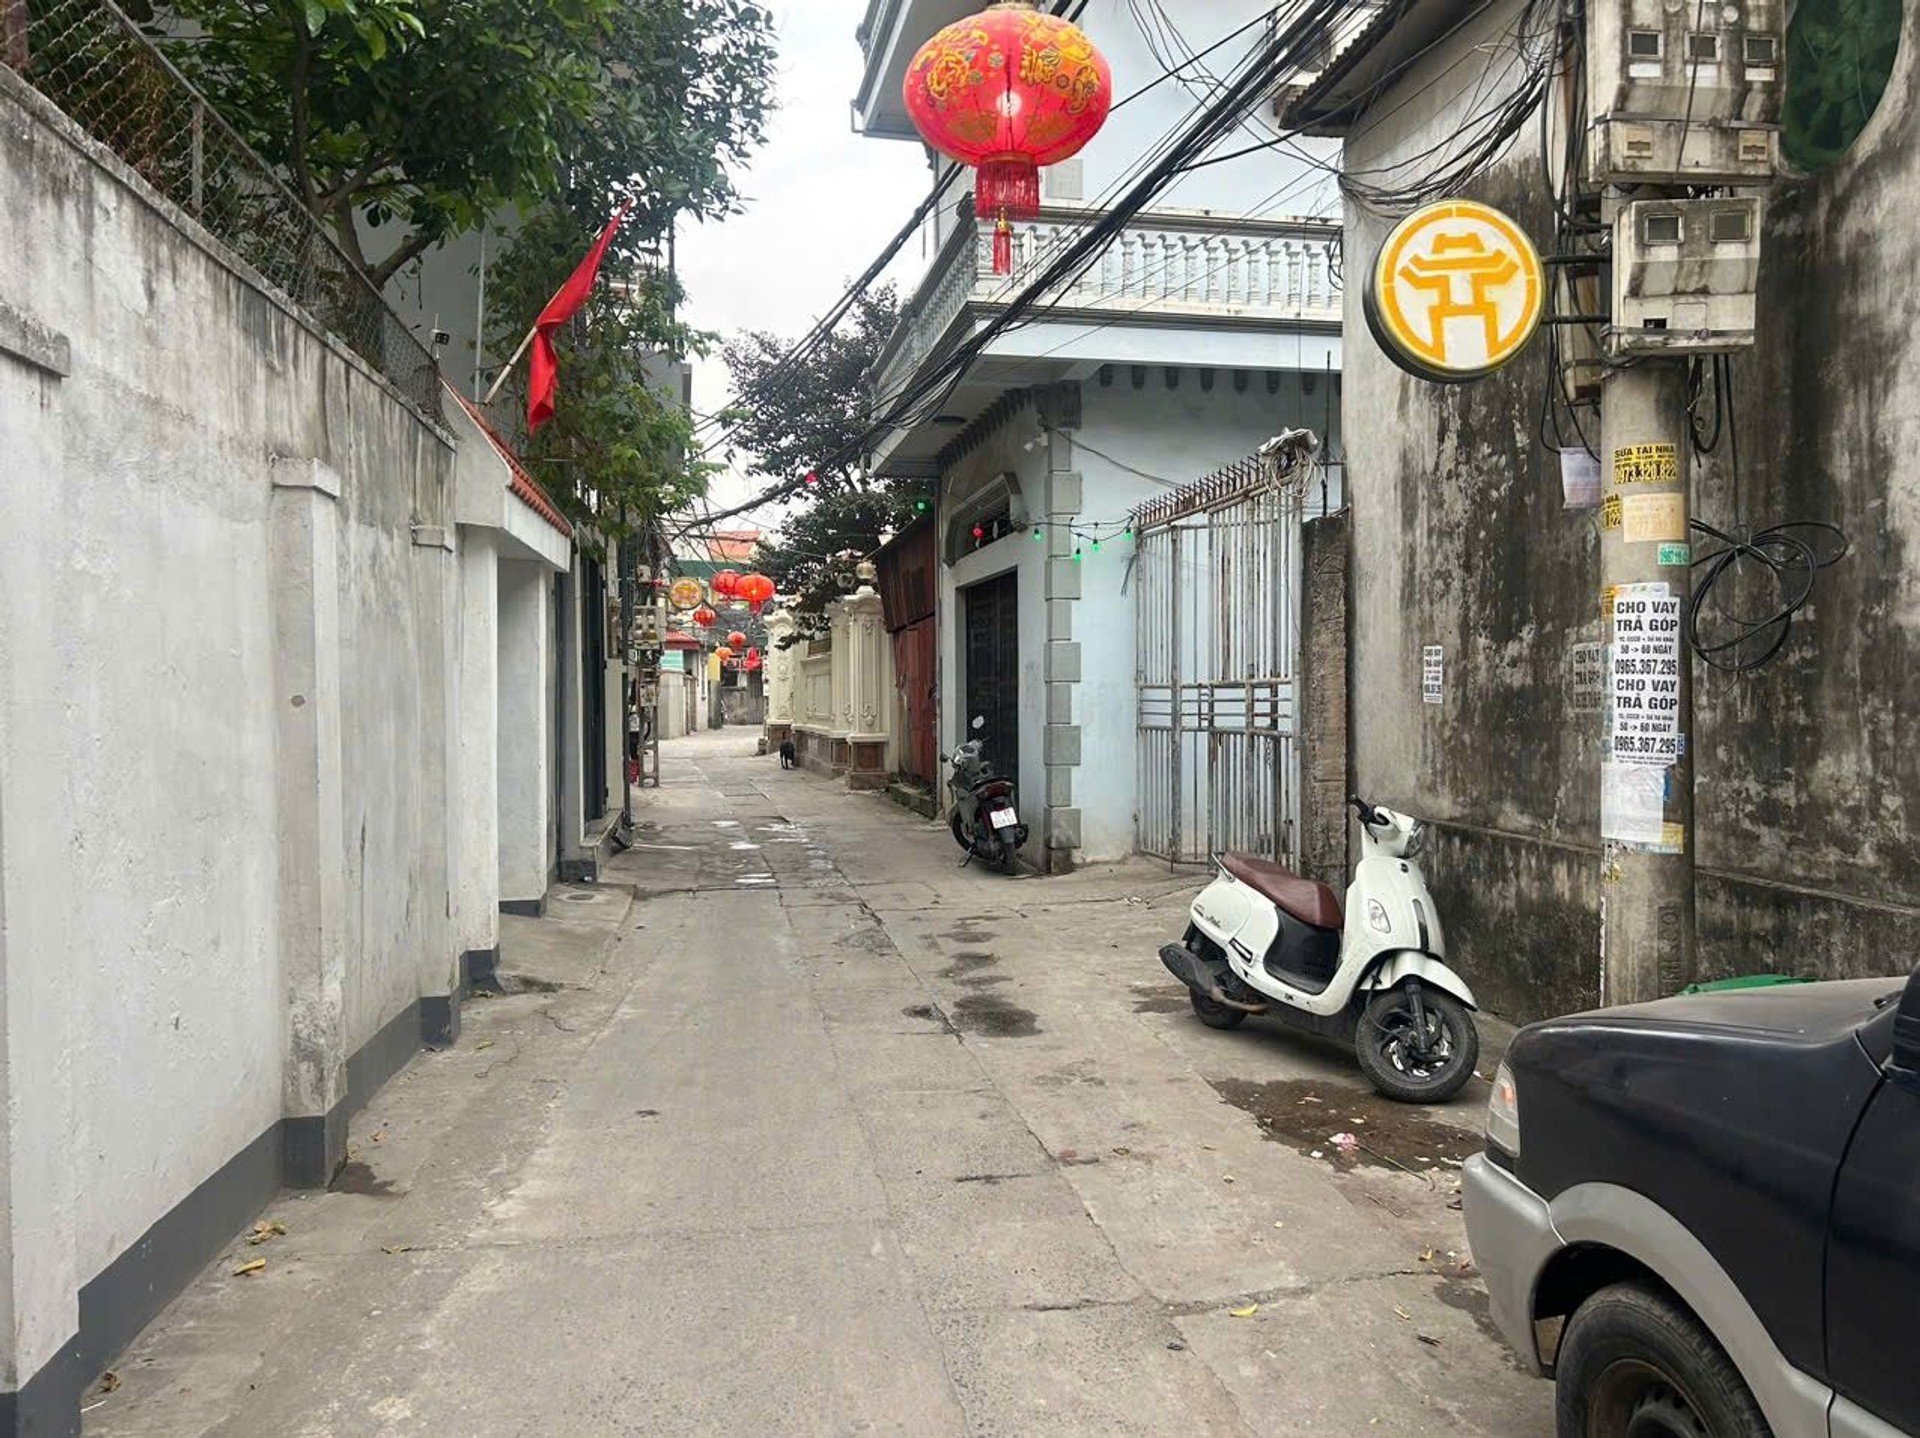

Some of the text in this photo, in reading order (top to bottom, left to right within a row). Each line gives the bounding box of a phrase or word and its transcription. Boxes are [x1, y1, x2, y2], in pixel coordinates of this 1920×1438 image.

[1617, 601, 1677, 614] CHO VAY
[1616, 615, 1678, 632] TRẢ GÓP
[1617, 679, 1677, 692] CHO VAY
[1616, 693, 1642, 709] TRẢ
[1648, 695, 1678, 711] GÓP
